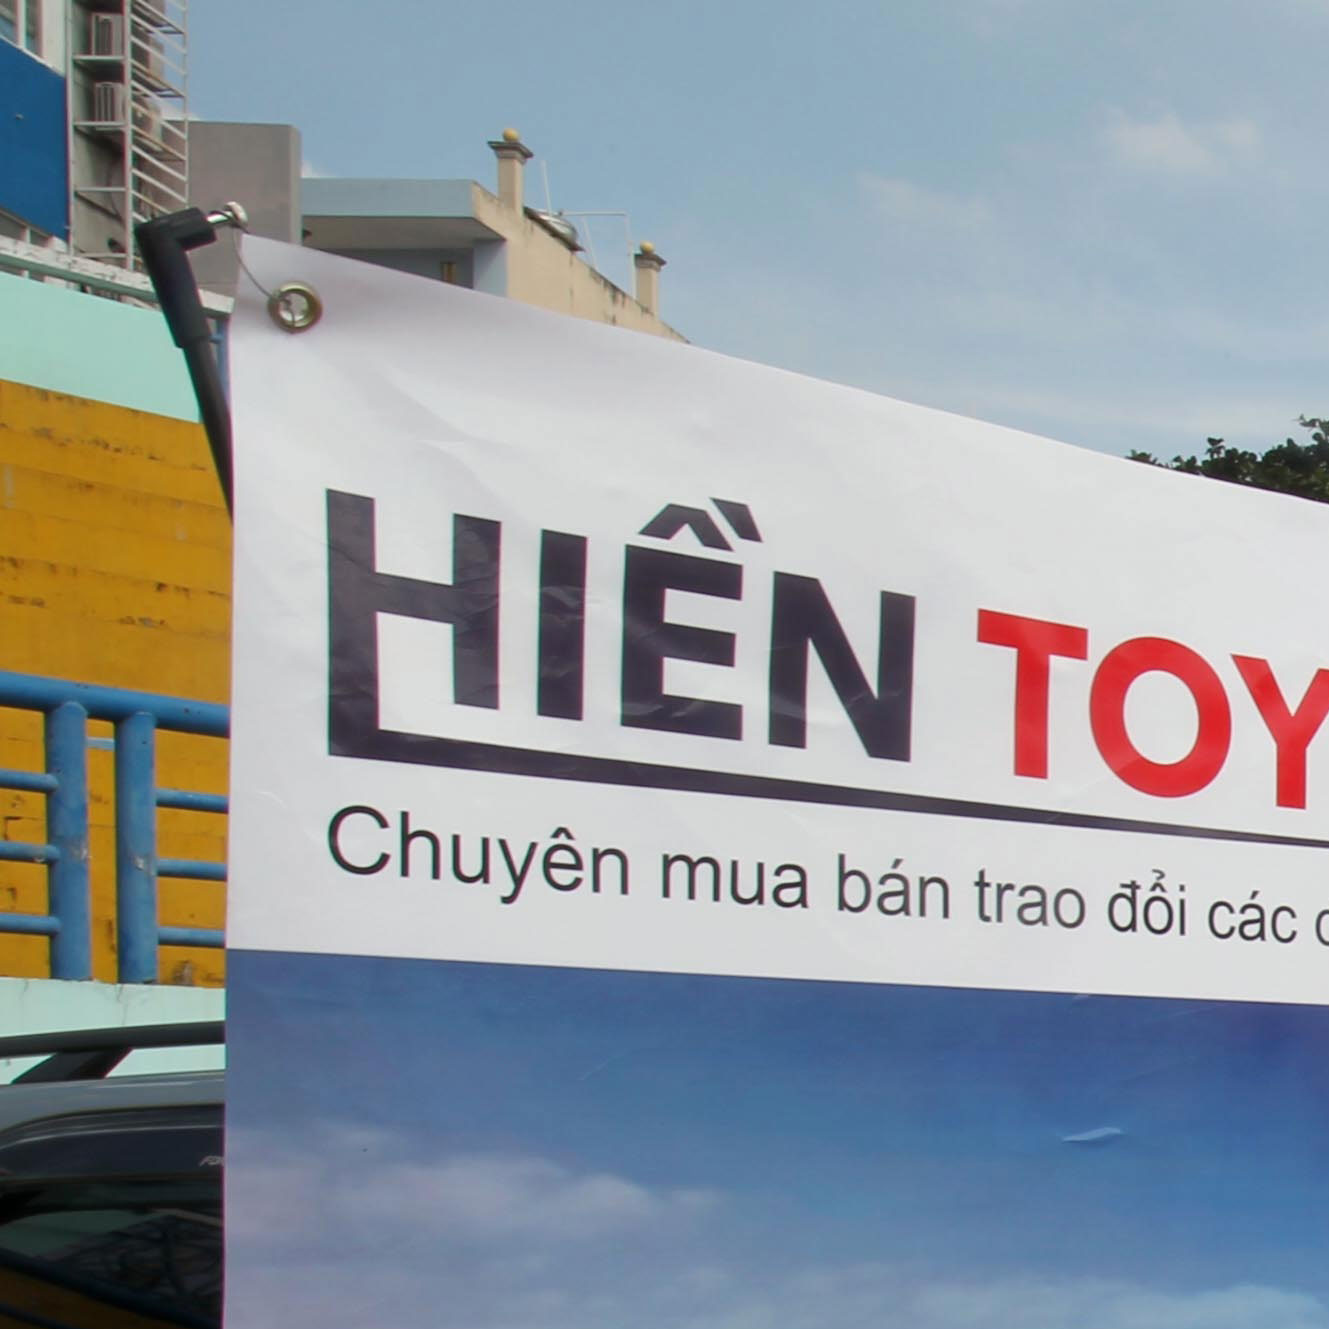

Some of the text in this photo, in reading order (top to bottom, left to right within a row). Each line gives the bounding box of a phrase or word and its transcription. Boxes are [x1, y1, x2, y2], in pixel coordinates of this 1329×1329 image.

[326, 489, 916, 762] HIỀN
[327, 805, 629, 905] Chuyên
[661, 853, 809, 909] mua
[837, 852, 949, 919] bán
[974, 869, 1085, 929] trao
[1108, 869, 1187, 936] đổi
[1209, 890, 1297, 944] các
